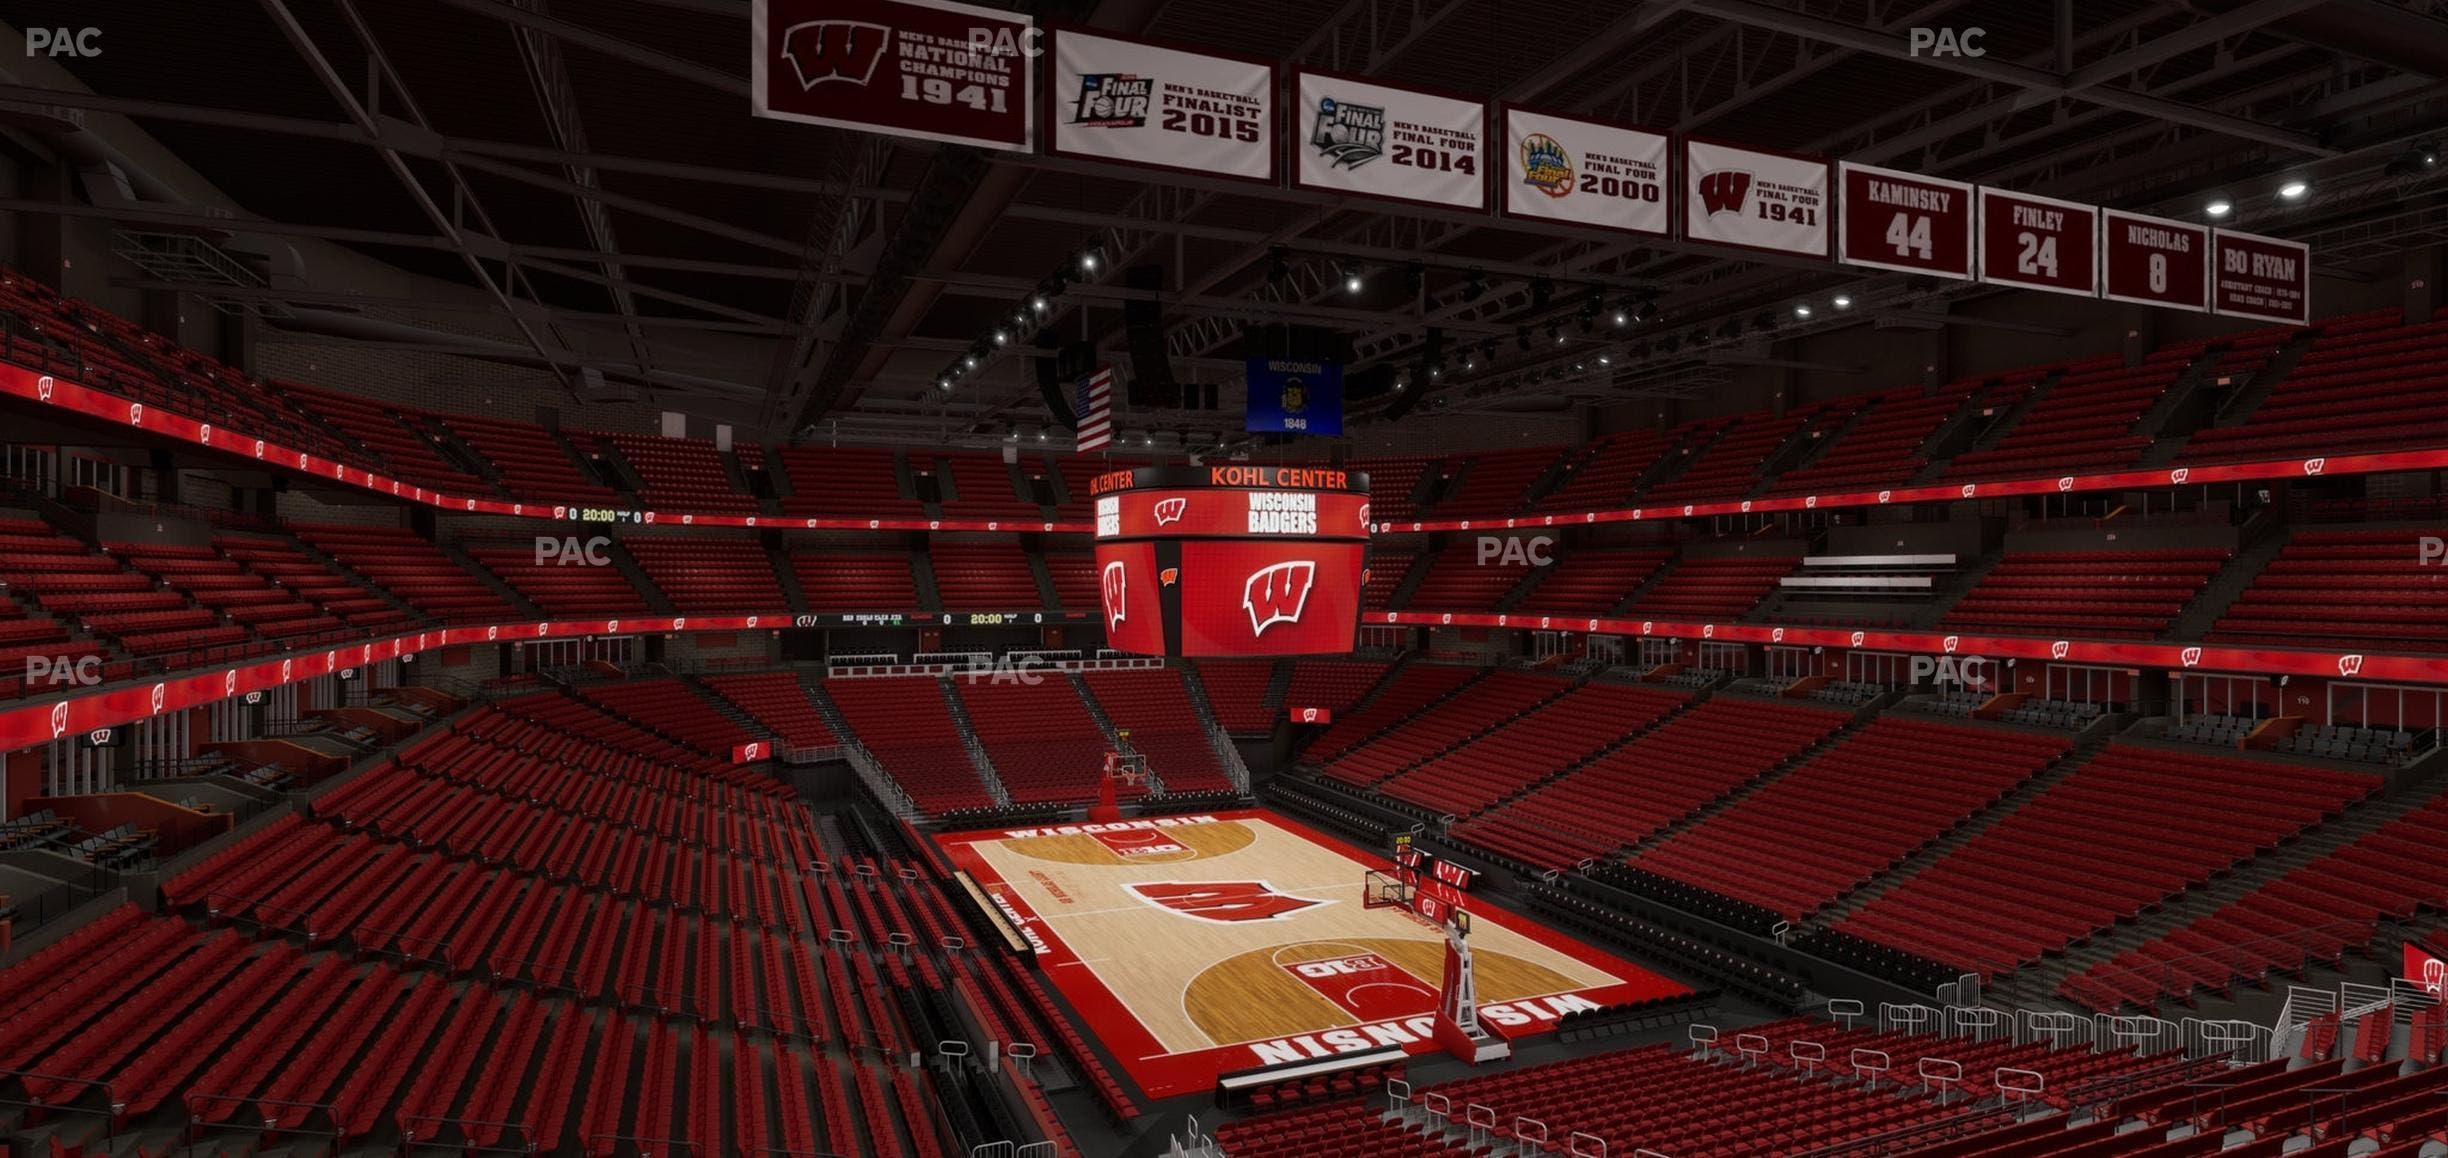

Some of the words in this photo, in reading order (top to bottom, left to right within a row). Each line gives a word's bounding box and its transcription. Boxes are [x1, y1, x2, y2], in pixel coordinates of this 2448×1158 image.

[899, 42, 1011, 73] NATIONAL
[899, 59, 1010, 87] CHAMPIONS
[901, 74, 1008, 114] 1941
[1101, 77, 1148, 96] FINAL
[1164, 83, 1194, 95] MEN'S
[1197, 88, 1260, 106] BASKETBALL
[1163, 94, 1261, 120] FINALIST
[1335, 103, 1382, 129] FINAL
[1163, 109, 1259, 143] 2015
[1394, 121, 1419, 131] MEN'S
[1422, 124, 1476, 141] BASKETBALL
[1393, 131, 1434, 146] FINAL
[1440, 137, 1475, 152] FOUR
[1392, 144, 1475, 175] 2014
[1585, 152, 1607, 162] MEN'S
[1610, 156, 1656, 170] BASKETBALL
[1585, 161, 1620, 175] FINAL
[1625, 168, 1656, 180] FOUR
[1580, 173, 1659, 203] 2000
[1757, 189, 1788, 202] FINAL
[1792, 195, 1819, 206] FOUR
[1868, 180, 1950, 213] KAMINSKY
[1758, 201, 1816, 226] 1941
[2013, 205, 2064, 232] FINLEY
[1885, 211, 1933, 260] 44
[2127, 225, 2190, 253] NICHOLAS
[2017, 231, 2058, 278] 24
[2224, 248, 2248, 274] BO
[2252, 253, 2296, 282] RYAN
[2149, 253, 2167, 294] 8
[1268, 360, 1322, 375] WISCONSIN
[1284, 418, 1307, 430] 1848
[1100, 470, 1133, 492] CENTER
[1211, 467, 1270, 487] KOHL
[1276, 468, 1347, 489] CENTER
[1249, 492, 1316, 512] WISCONSIN
[583, 509, 615, 522] 20:00
[1248, 511, 1317, 534] BADGERS
[1243, 560, 1316, 637] W
[971, 613, 1002, 625] 20:00
[1004, 815, 1219, 838] WISCONSIN
[1249, 994, 1603, 1066] WISONSIN
